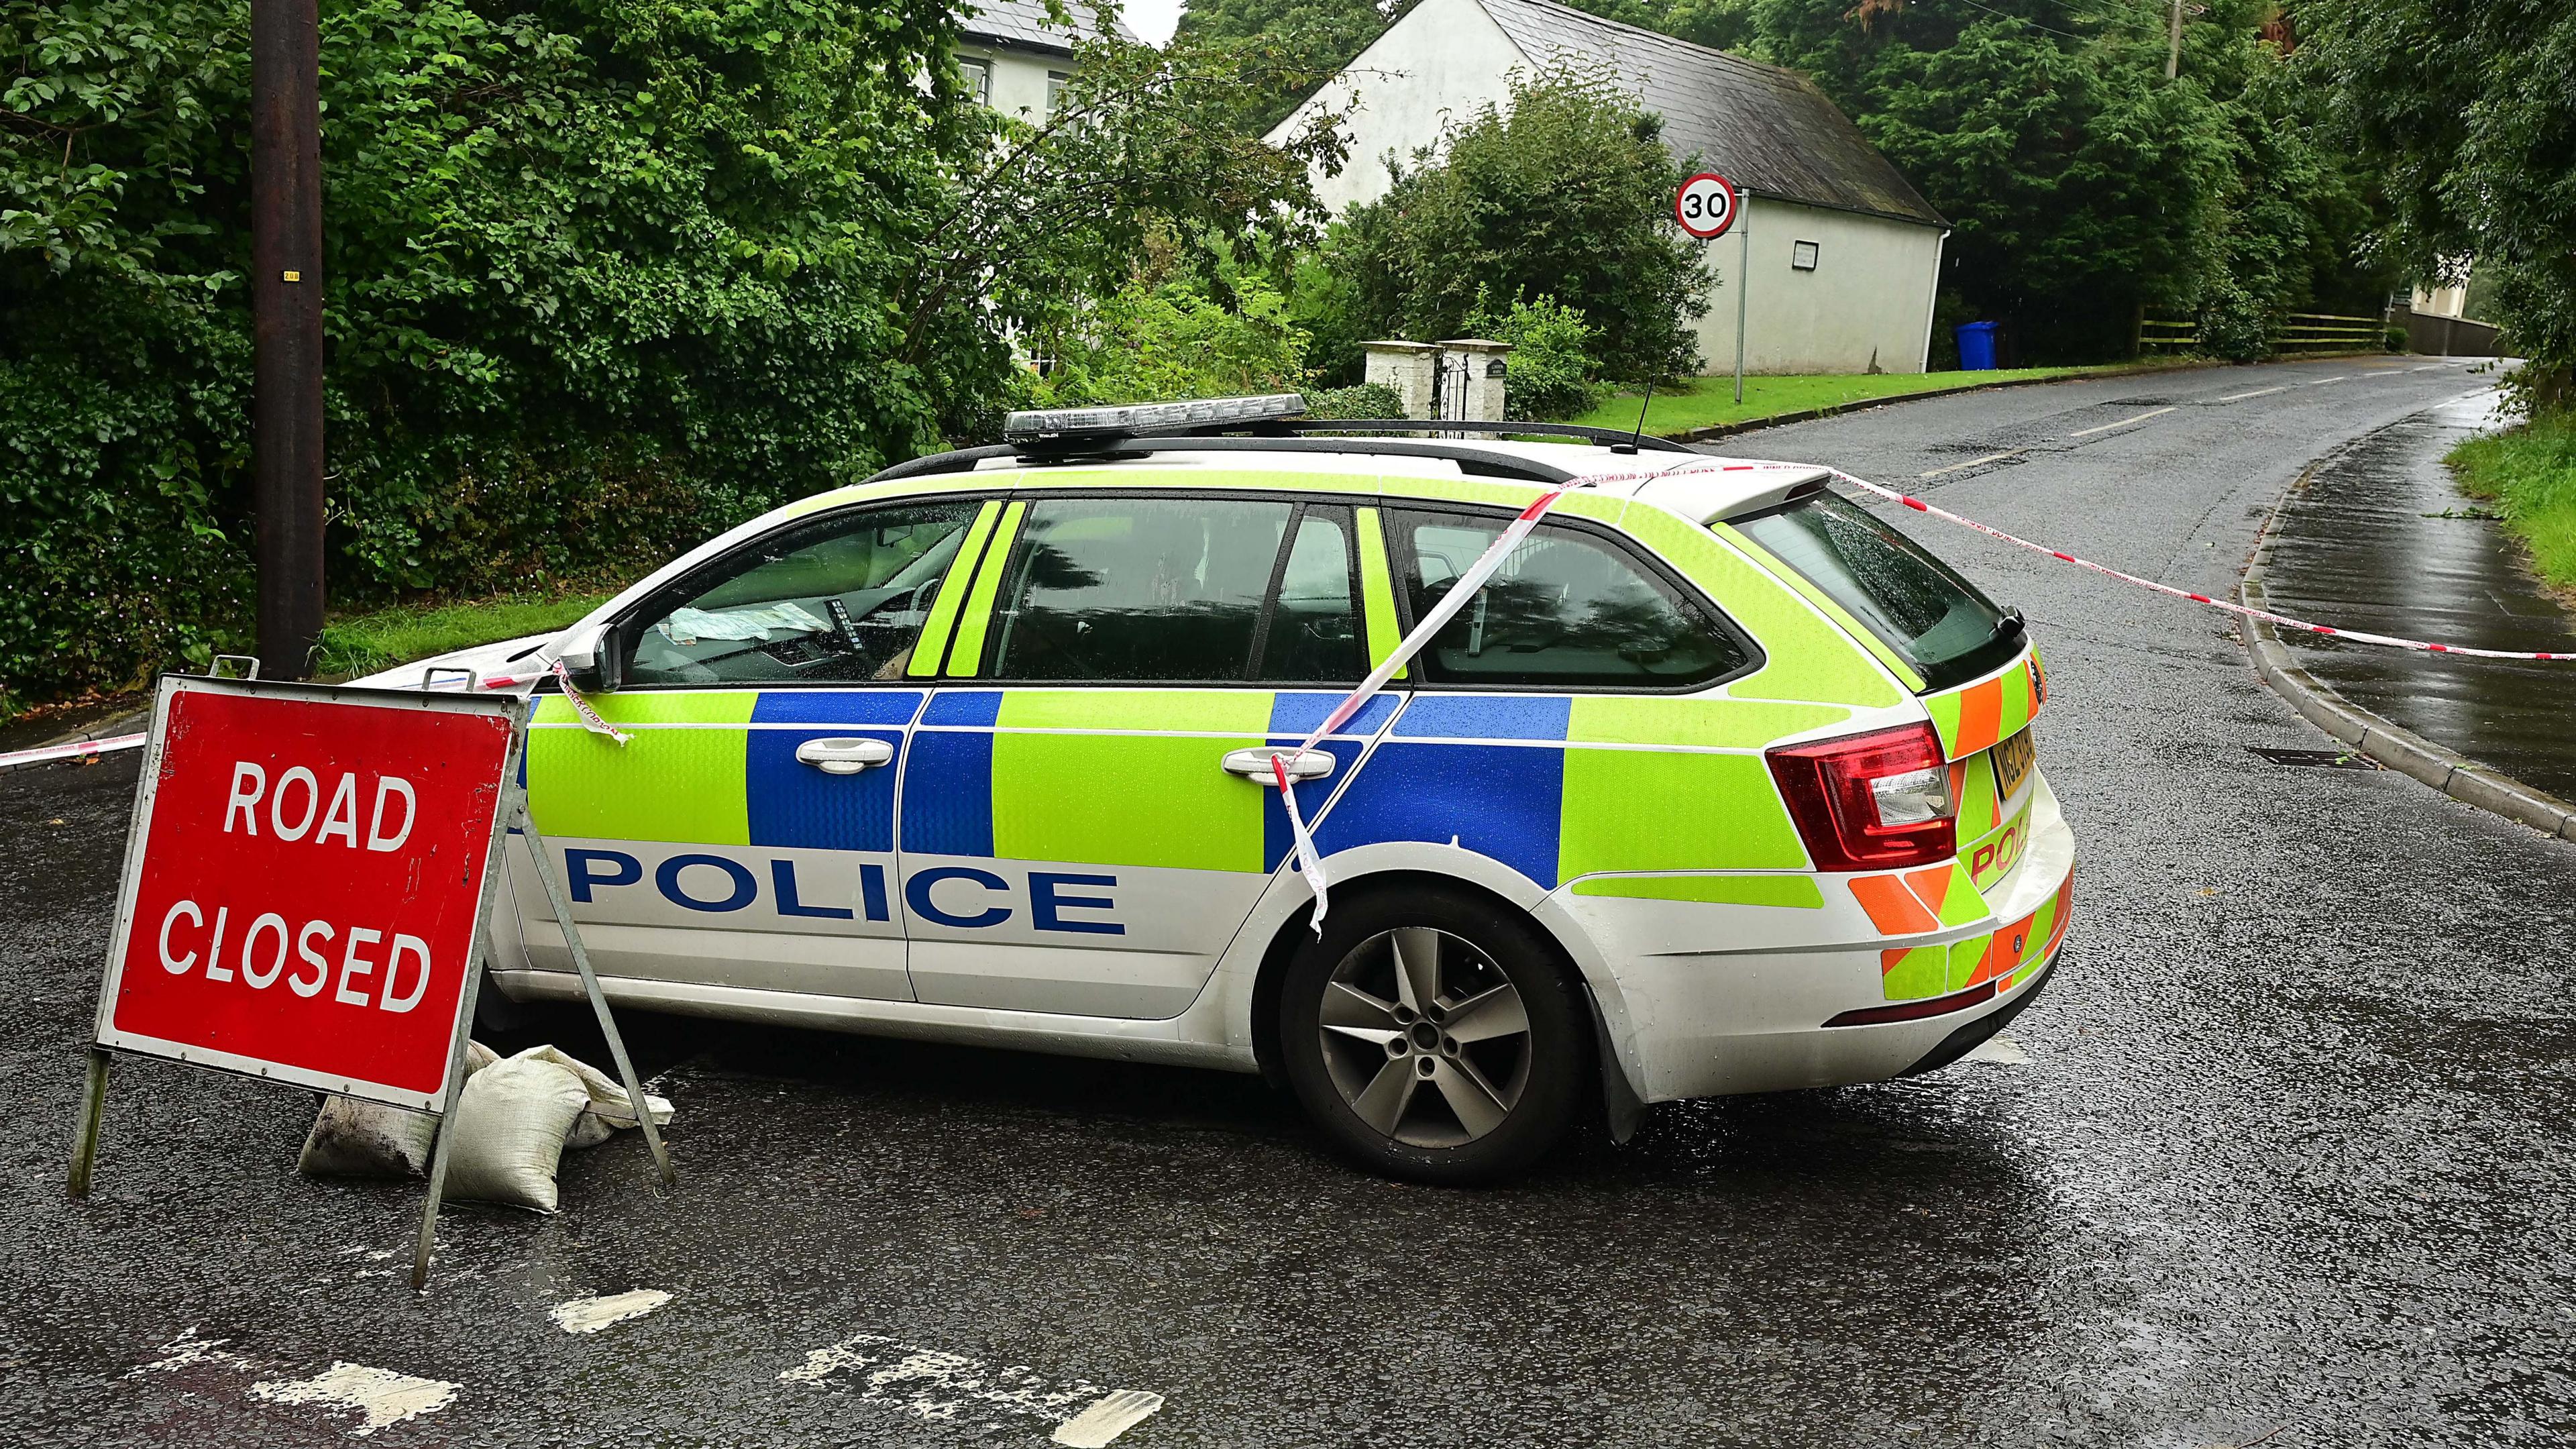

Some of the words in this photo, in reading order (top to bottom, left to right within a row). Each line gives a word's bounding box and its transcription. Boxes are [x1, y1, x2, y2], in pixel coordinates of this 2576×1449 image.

[1684, 193, 1727, 219] 30
[223, 761, 417, 853] ROAD
[1997, 737, 2021, 790] NGZ
[564, 848, 1126, 935] POLICE
[159, 900, 431, 1013] CLOSED
